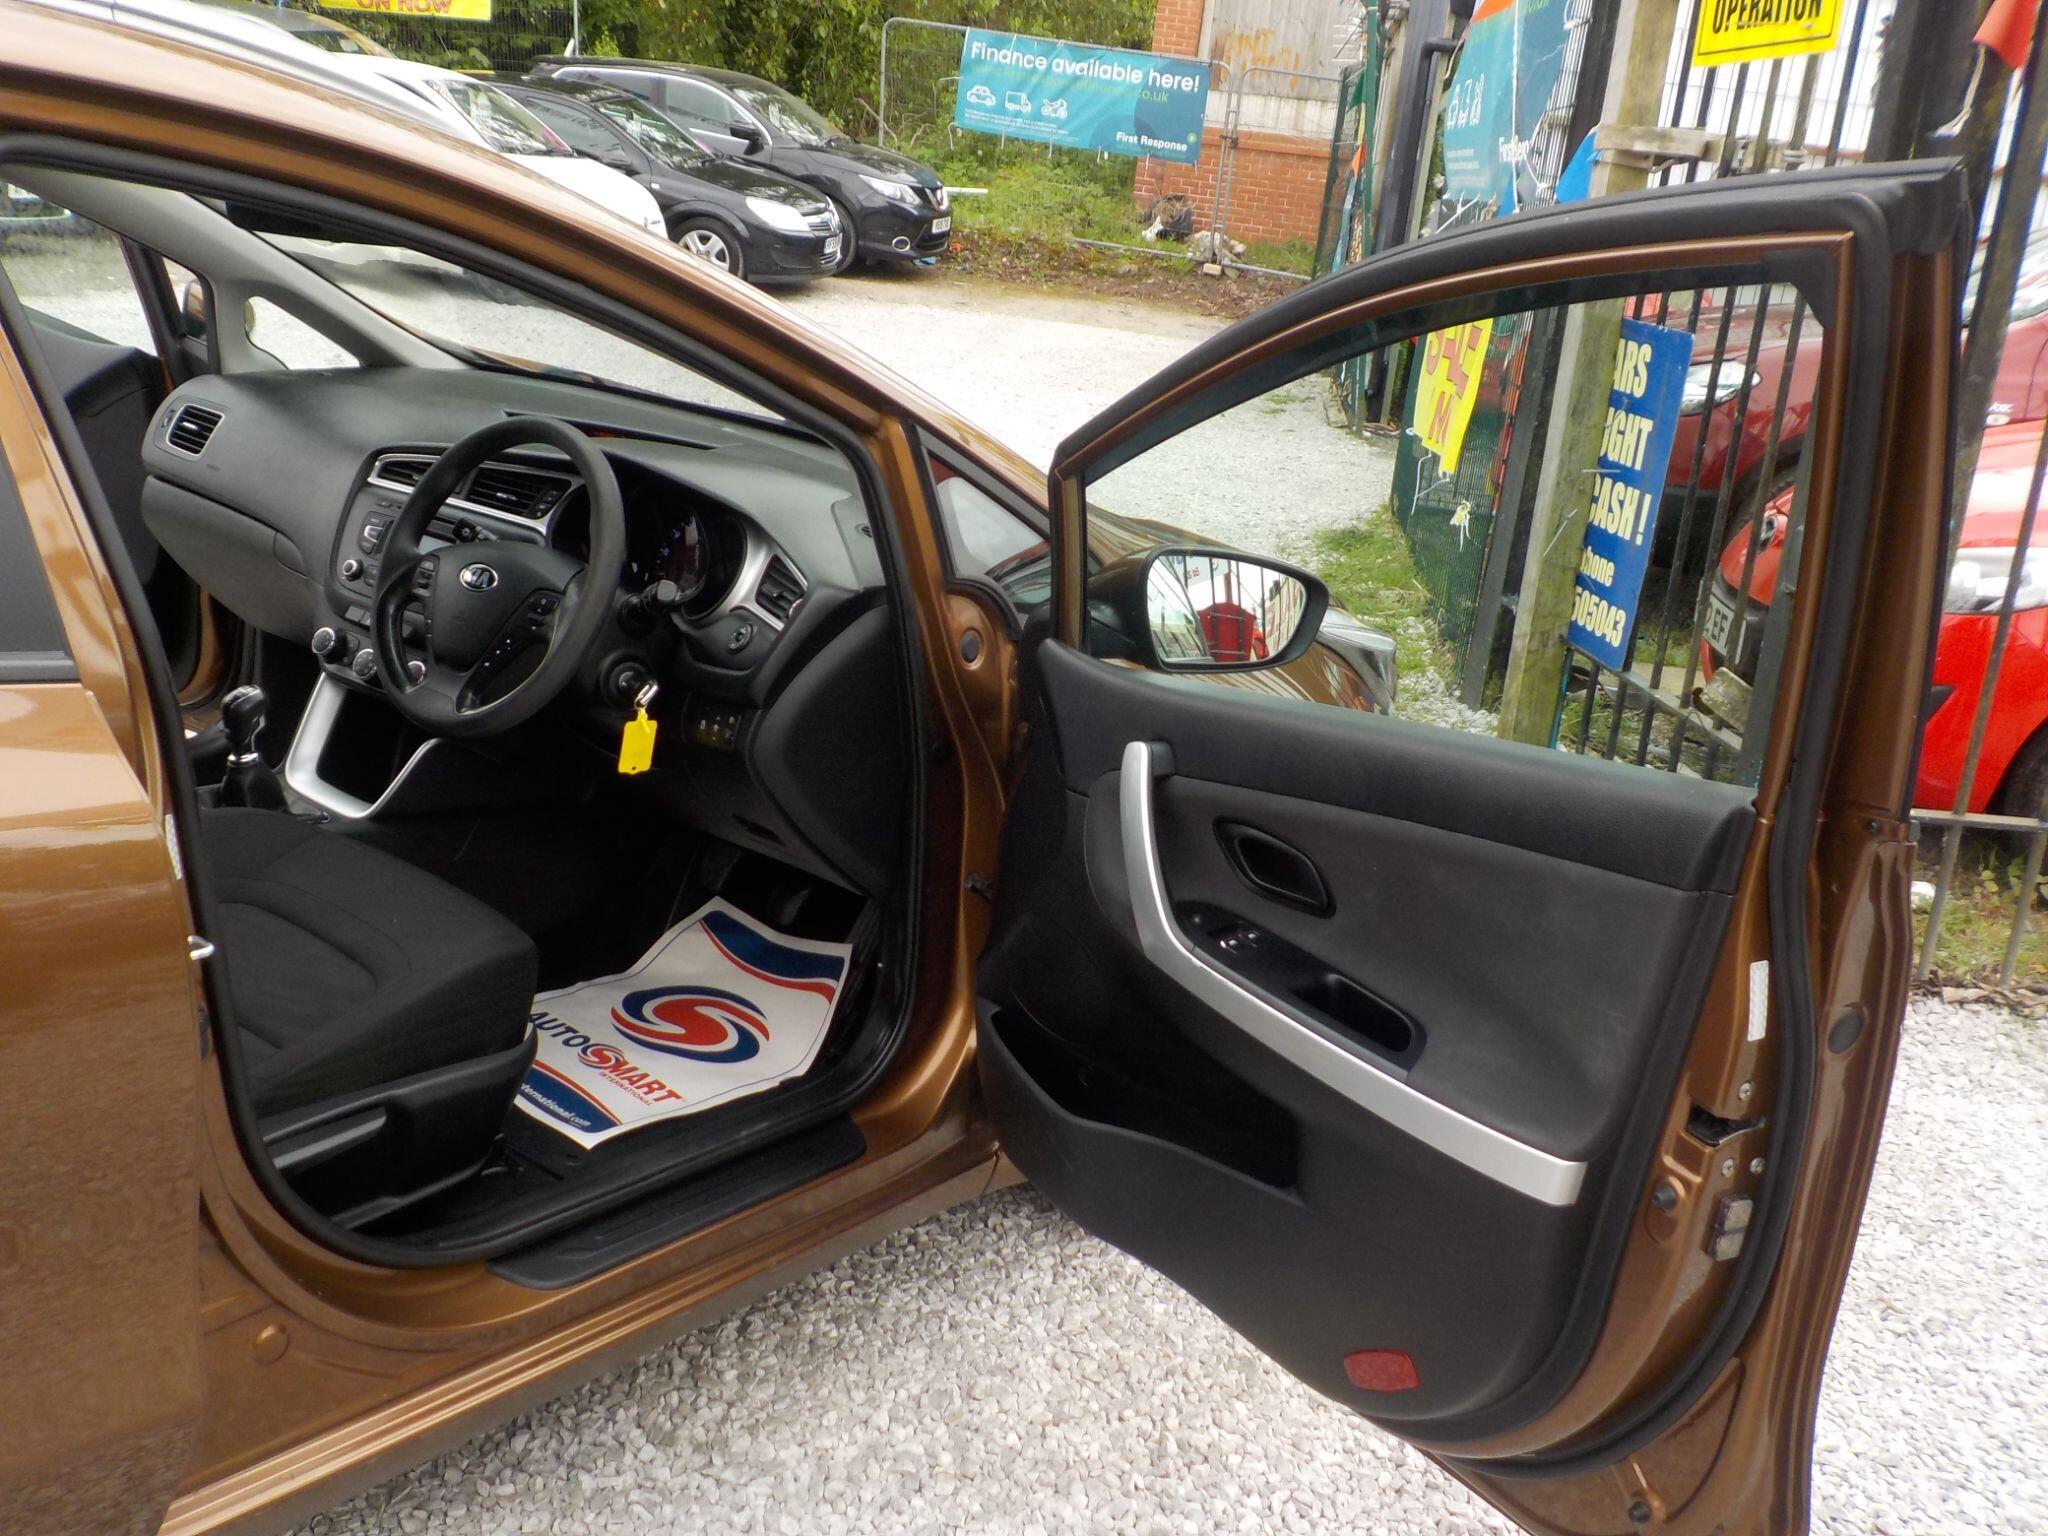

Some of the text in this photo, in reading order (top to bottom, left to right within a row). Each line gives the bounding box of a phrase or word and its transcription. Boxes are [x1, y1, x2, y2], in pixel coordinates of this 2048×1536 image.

[1712, 0, 1822, 34] OPERATION
[970, 41, 1048, 70] Finance
[1051, 54, 1143, 85] available
[1148, 67, 1200, 93] here!
[1116, 131, 1138, 144] First
[1140, 135, 1188, 152] Response
[598, 1070, 653, 1107] INTERNATIONAL
